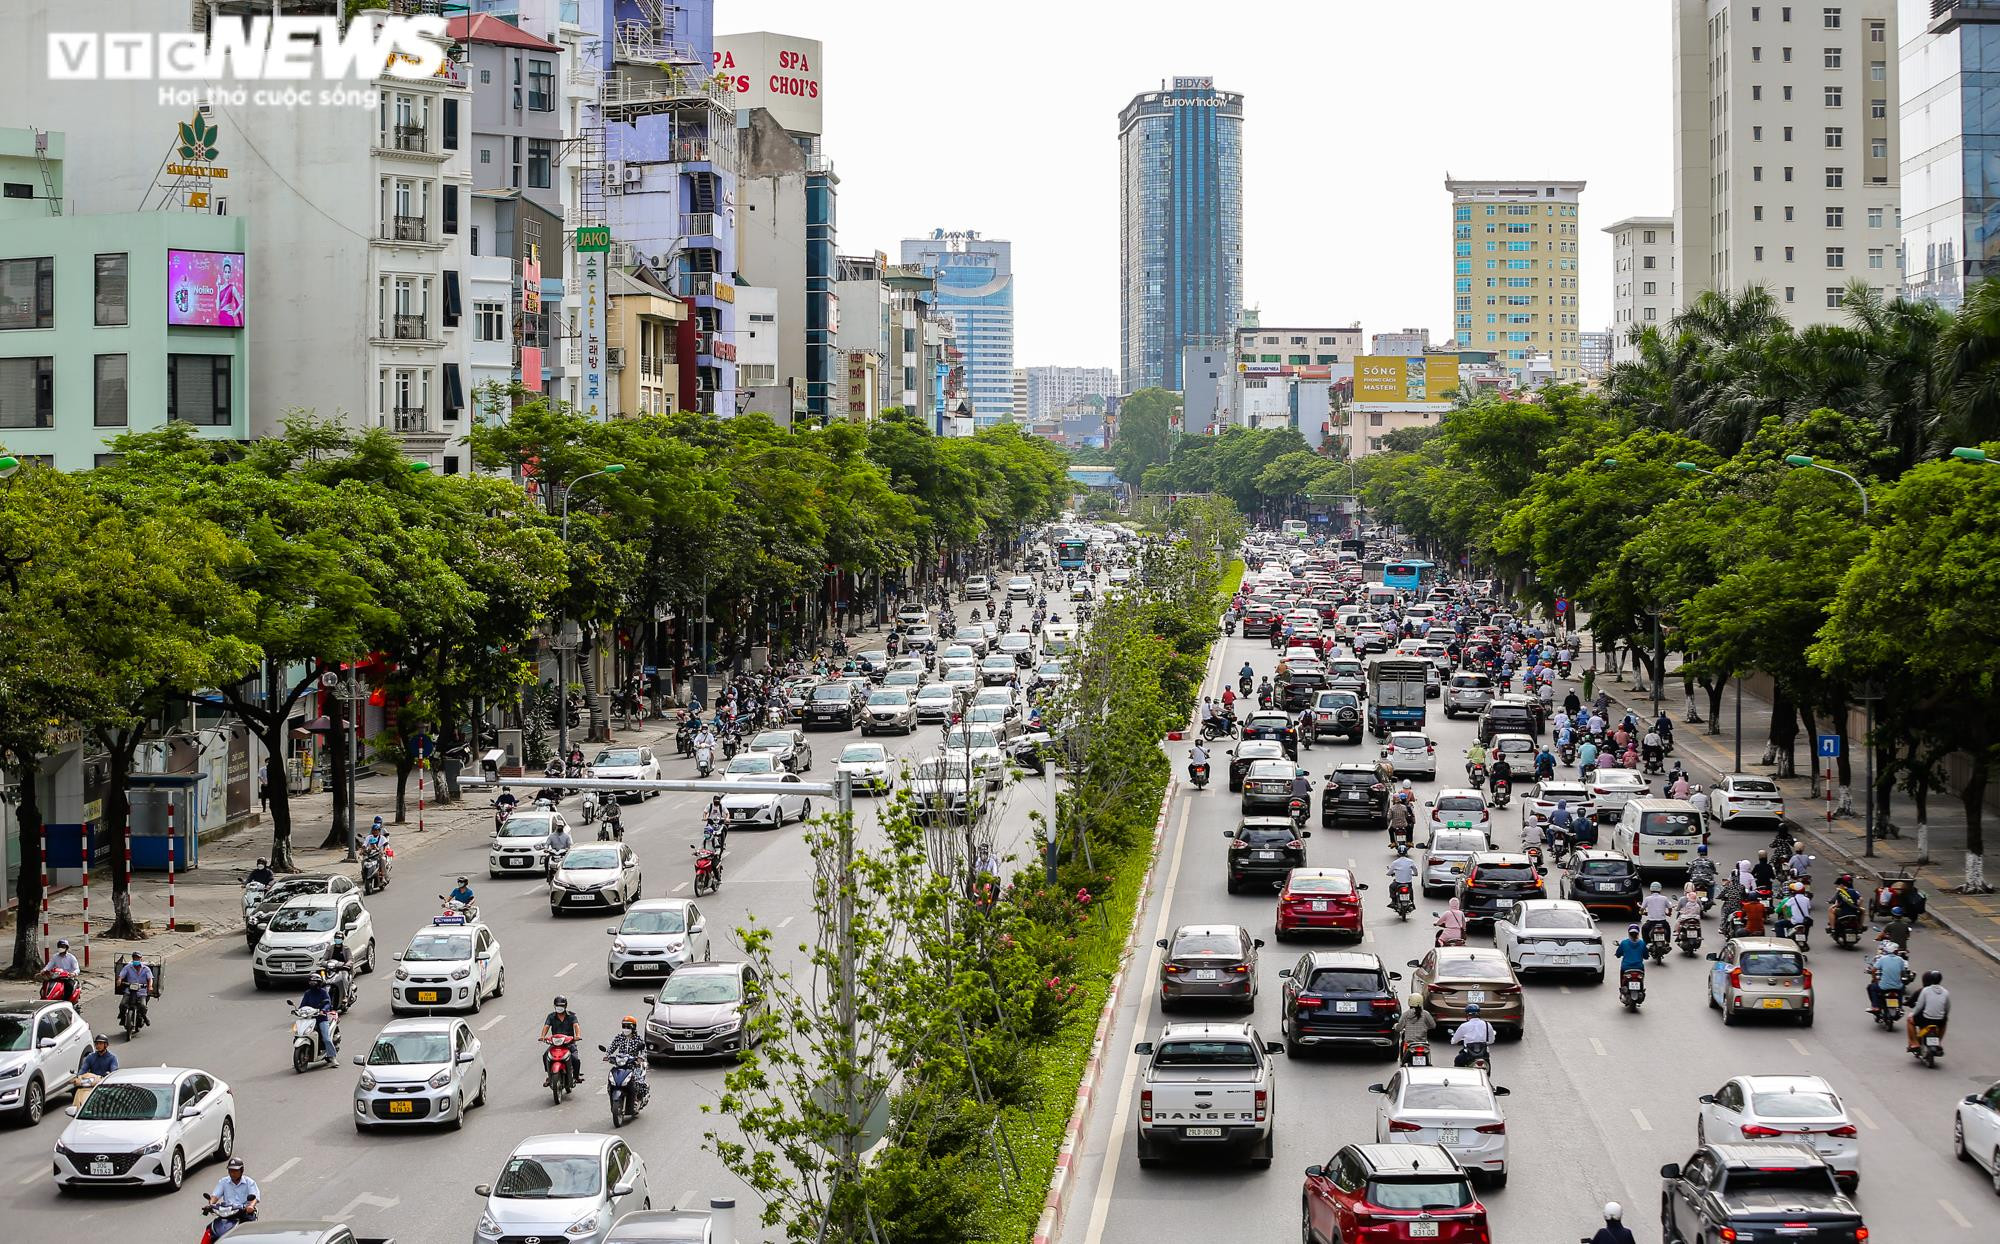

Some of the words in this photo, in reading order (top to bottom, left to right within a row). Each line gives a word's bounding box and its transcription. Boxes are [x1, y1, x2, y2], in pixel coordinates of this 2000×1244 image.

[712, 50, 735, 69] PA
[779, 50, 808, 72] SPA
[769, 75, 818, 98] CHOI'S
[1175, 78, 1200, 88] BIDV
[1163, 95, 1227, 107] Eurowindow
[579, 232, 609, 246] JAKO
[952, 254, 990, 267] VNPT
[588, 284, 597, 329] CAFE
[587, 333, 599, 369] 노래방
[1364, 365, 1396, 375] SỐNG
[588, 373, 599, 400] 맥주
